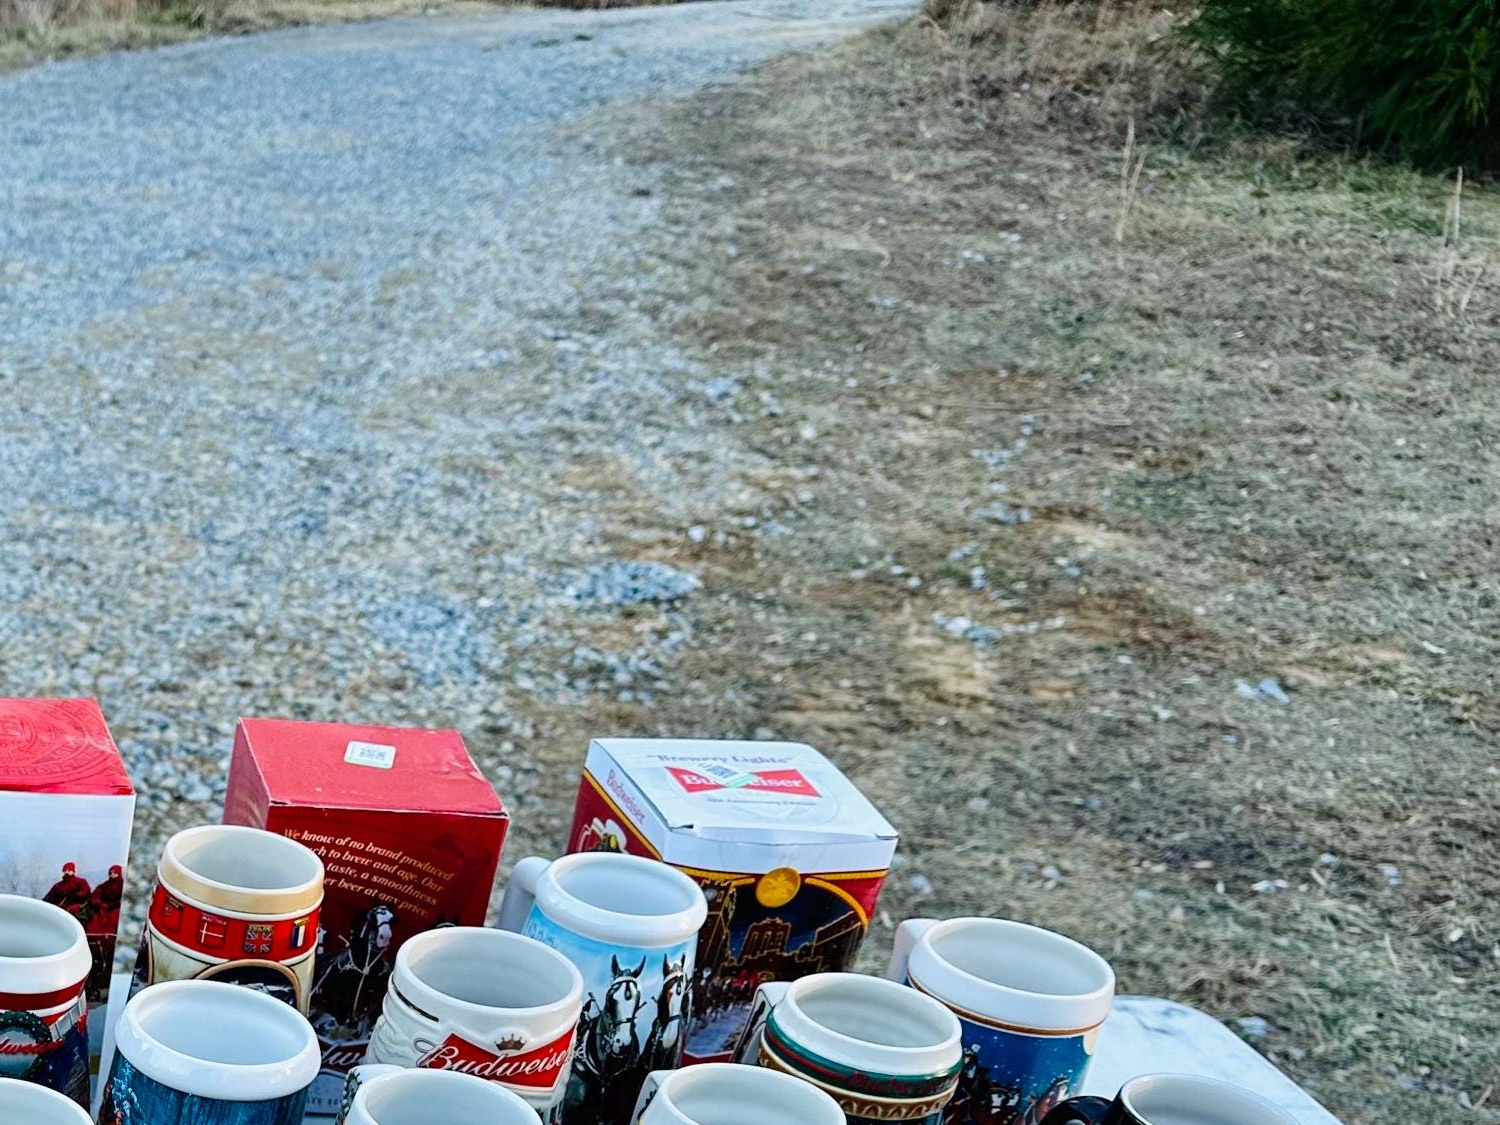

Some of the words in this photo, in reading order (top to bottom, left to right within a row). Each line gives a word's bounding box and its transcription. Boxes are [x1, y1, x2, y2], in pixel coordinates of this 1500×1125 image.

[284, 829, 300, 840] We
[301, 830, 335, 845] know
[335, 835, 351, 846] of
[349, 840, 365, 850] no
[365, 842, 401, 861] brand
[400, 856, 455, 881] produced
[328, 849, 340, 859] to
[342, 850, 373, 866] brew
[373, 858, 400, 874] and
[421, 876, 444, 893] Our
[326, 862, 358, 878] taste,
[360, 871, 369, 880] a
[371, 875, 438, 906] smoothness
[338, 877, 365, 893] beer
[364, 887, 379, 897] at
[378, 891, 399, 905] any
[399, 898, 429, 919] price.
